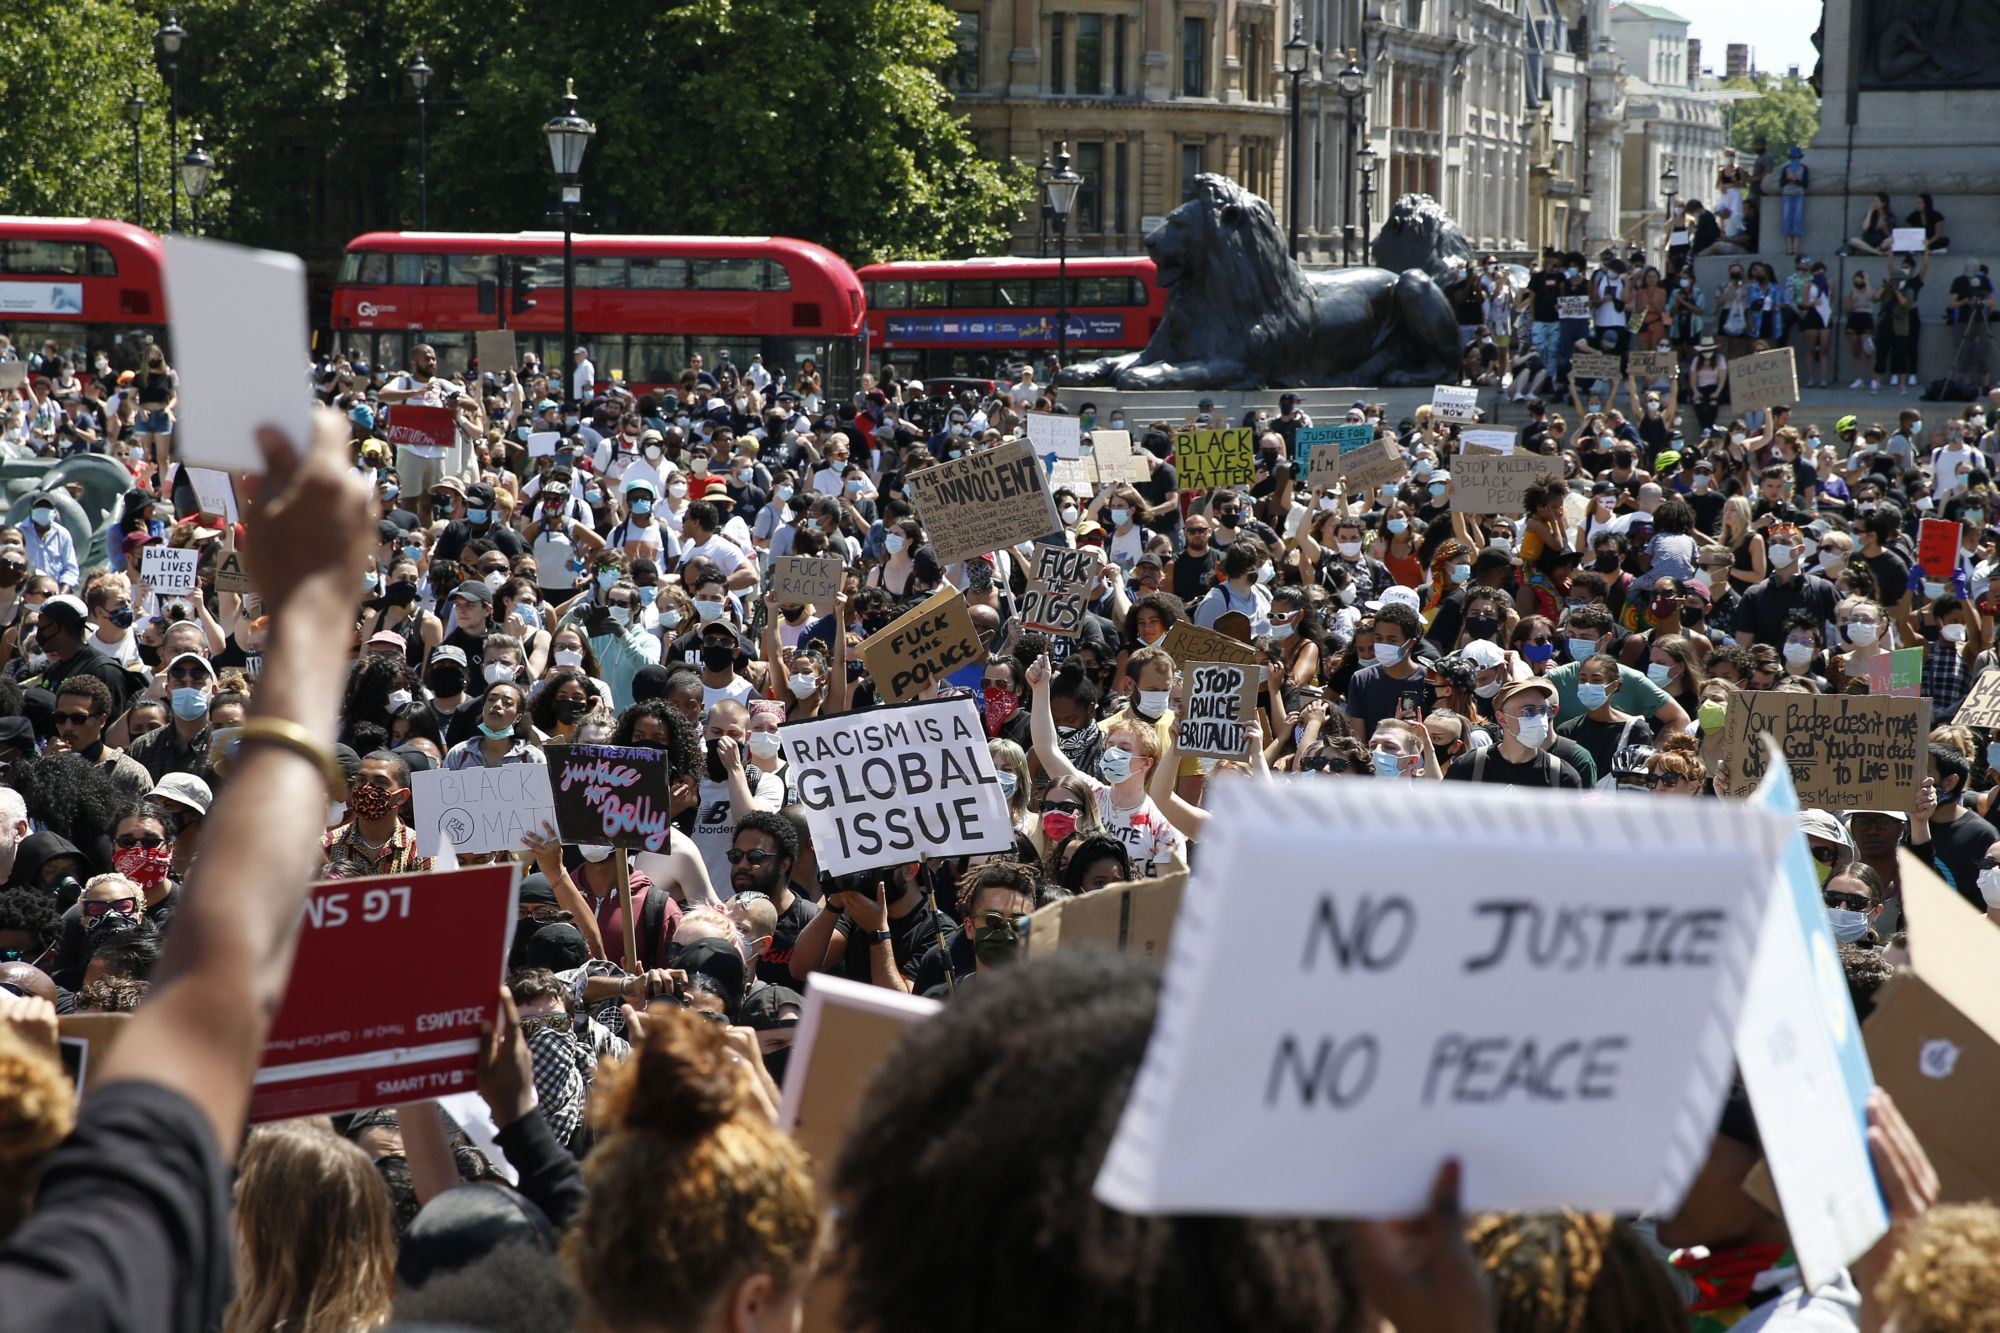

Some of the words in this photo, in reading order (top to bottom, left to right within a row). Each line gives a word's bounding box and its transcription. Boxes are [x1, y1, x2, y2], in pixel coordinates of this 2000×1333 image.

[357, 301, 378, 317] Go
[1737, 360, 1779, 378] BLACK
[1435, 401, 1472, 411] SUPREMACY
[1443, 409, 1463, 417] NOW
[1178, 430, 1251, 456] BLACK
[1304, 430, 1345, 440] JUSTICE
[1348, 429, 1367, 438] FOR
[1183, 452, 1250, 472] LIVES
[1309, 459, 1334, 473] BLM
[1318, 449, 1325, 458] #
[910, 471, 940, 490] THE
[942, 464, 955, 479] UK
[959, 460, 969, 475] IS
[970, 452, 995, 471] NOT
[934, 455, 1042, 506] INNOCENT
[1178, 469, 1255, 489] MATTER
[1455, 461, 1490, 475] STOP
[1497, 461, 1547, 474] KILLING
[1460, 475, 1513, 488] BLACK
[1487, 489, 1525, 504] PEOP
[145, 549, 180, 560] BLACK
[161, 562, 193, 573] LIVES
[1038, 548, 1092, 584] FUCK
[142, 574, 191, 588] MATTER
[790, 559, 830, 578] FUCK
[783, 577, 837, 597] RACISM
[1047, 578, 1070, 593] THE
[1021, 591, 1088, 632] PIGS!
[890, 612, 950, 655] FUCK
[685, 650, 706, 665] BL
[908, 636, 943, 660] THE
[1174, 632, 1249, 664] RESPECT
[891, 637, 977, 698] POLICE
[1193, 668, 1241, 695] STOP
[1189, 695, 1241, 721] POLICE
[1740, 693, 1779, 742] Your
[1786, 699, 1832, 740] Badge
[1833, 699, 1883, 736] doesn't
[791, 721, 910, 764] RACISM
[914, 718, 944, 743] IS
[953, 715, 973, 741] A
[1748, 734, 1766, 761] yo
[1845, 734, 1865, 760] do
[1867, 740, 1885, 759] not
[1887, 739, 1916, 761] decide
[570, 745, 577, 756] 2
[580, 745, 626, 759] METRES
[626, 748, 664, 762] APART
[560, 758, 642, 792] justice
[796, 746, 998, 811] GLOBAL
[1833, 760, 1852, 786] to
[1894, 763, 1913, 787] !!!
[439, 769, 537, 806] BLACK
[1818, 787, 1863, 806] Matter
[481, 804, 556, 847] MATT
[597, 794, 670, 853] Belly
[698, 824, 737, 834] border
[835, 797, 984, 859] ISSUE
[303, 893, 349, 929] SM
[362, 886, 412, 922] LG
[1302, 891, 1418, 973] NO
[1461, 899, 1727, 974] JUSTICE
[416, 1006, 485, 1033] 32LM63
[1263, 1033, 1380, 1110] NO
[1421, 1032, 1629, 1107] PEACE
[376, 1074, 426, 1097] SMART
[430, 1073, 449, 1088] TV
